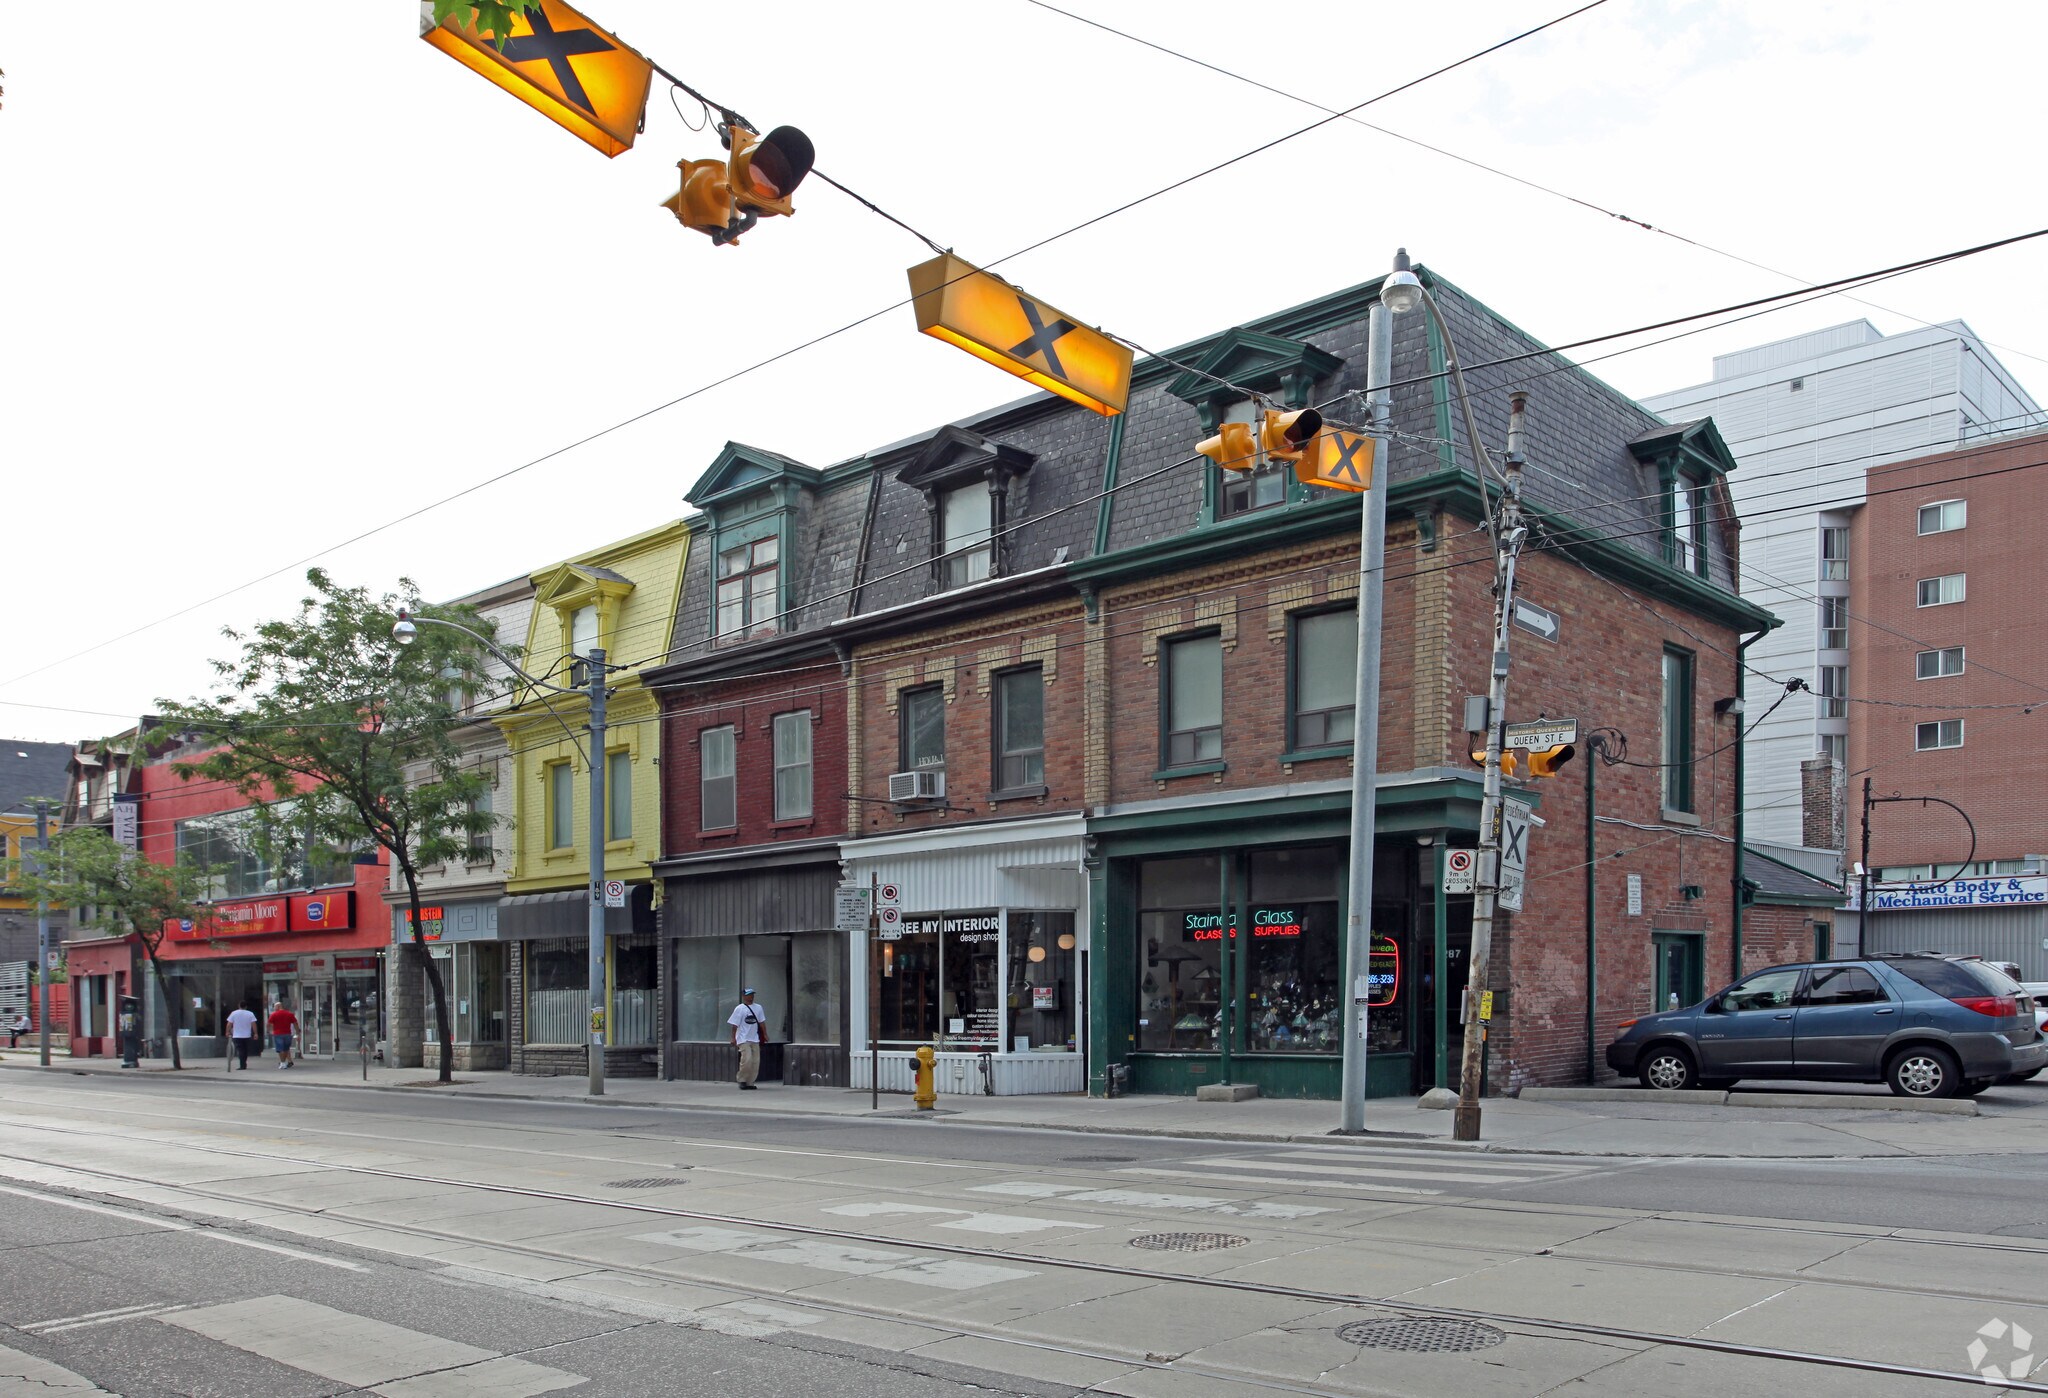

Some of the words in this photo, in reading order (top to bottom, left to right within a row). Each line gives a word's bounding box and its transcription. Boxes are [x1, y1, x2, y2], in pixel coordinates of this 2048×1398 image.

[1513, 735, 1540, 746] QUEEN
[1505, 804, 1529, 821] PEDESTRIAN
[1445, 877, 1473, 885] CROSSING
[1905, 883, 1948, 895] Auto
[1954, 880, 2001, 896] Body
[2007, 878, 2022, 891] &
[1877, 892, 1974, 909] Mechanical
[1978, 890, 2045, 905] Service
[254, 903, 279, 919] Moore
[1254, 909, 1295, 926] Glass
[900, 921, 919, 935] REE
[922, 920, 940, 934] MY
[943, 916, 999, 932] INTERIOR
[1194, 927, 1237, 941] CLASSS
[1254, 924, 1301, 937] SUPPLIES
[959, 933, 982, 944] design
[983, 932, 999, 943] shop
[1446, 949, 1462, 959] 87
